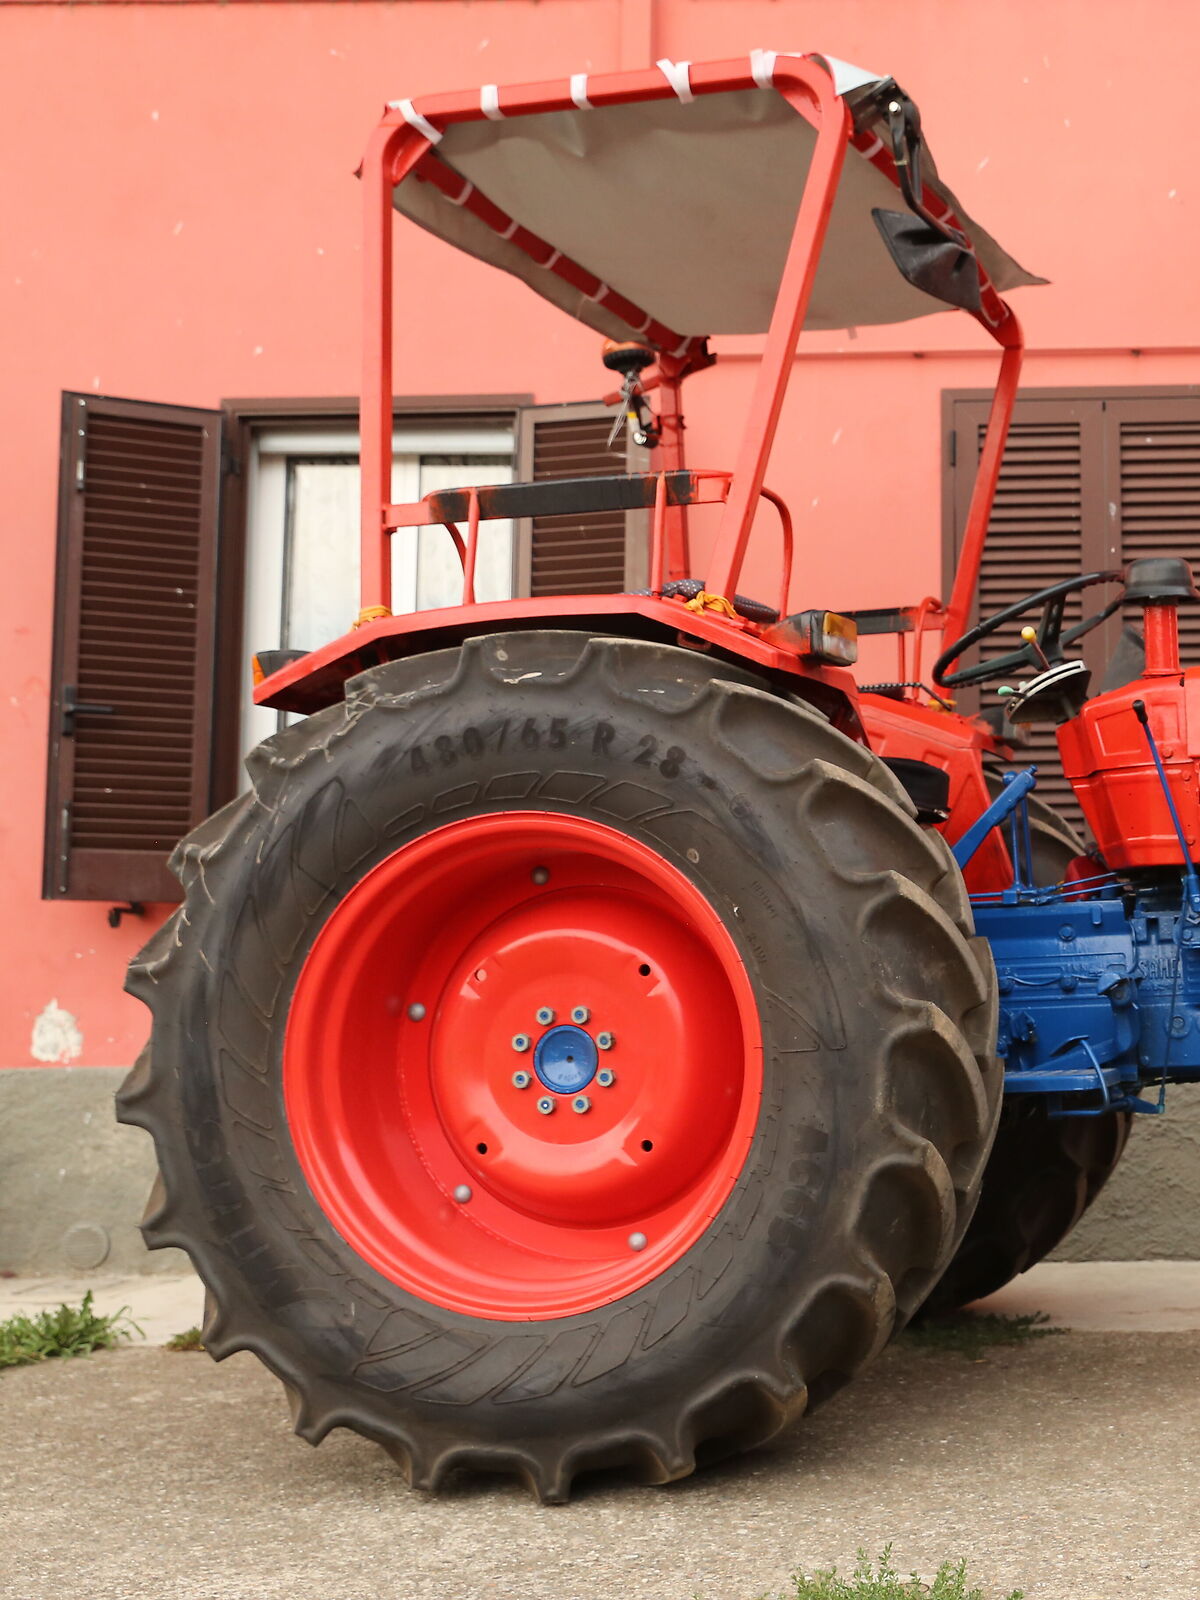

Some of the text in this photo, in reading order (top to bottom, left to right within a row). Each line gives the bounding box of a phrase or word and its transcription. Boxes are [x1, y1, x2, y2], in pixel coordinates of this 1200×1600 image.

[410, 717, 688, 780] 480/65 R 28
